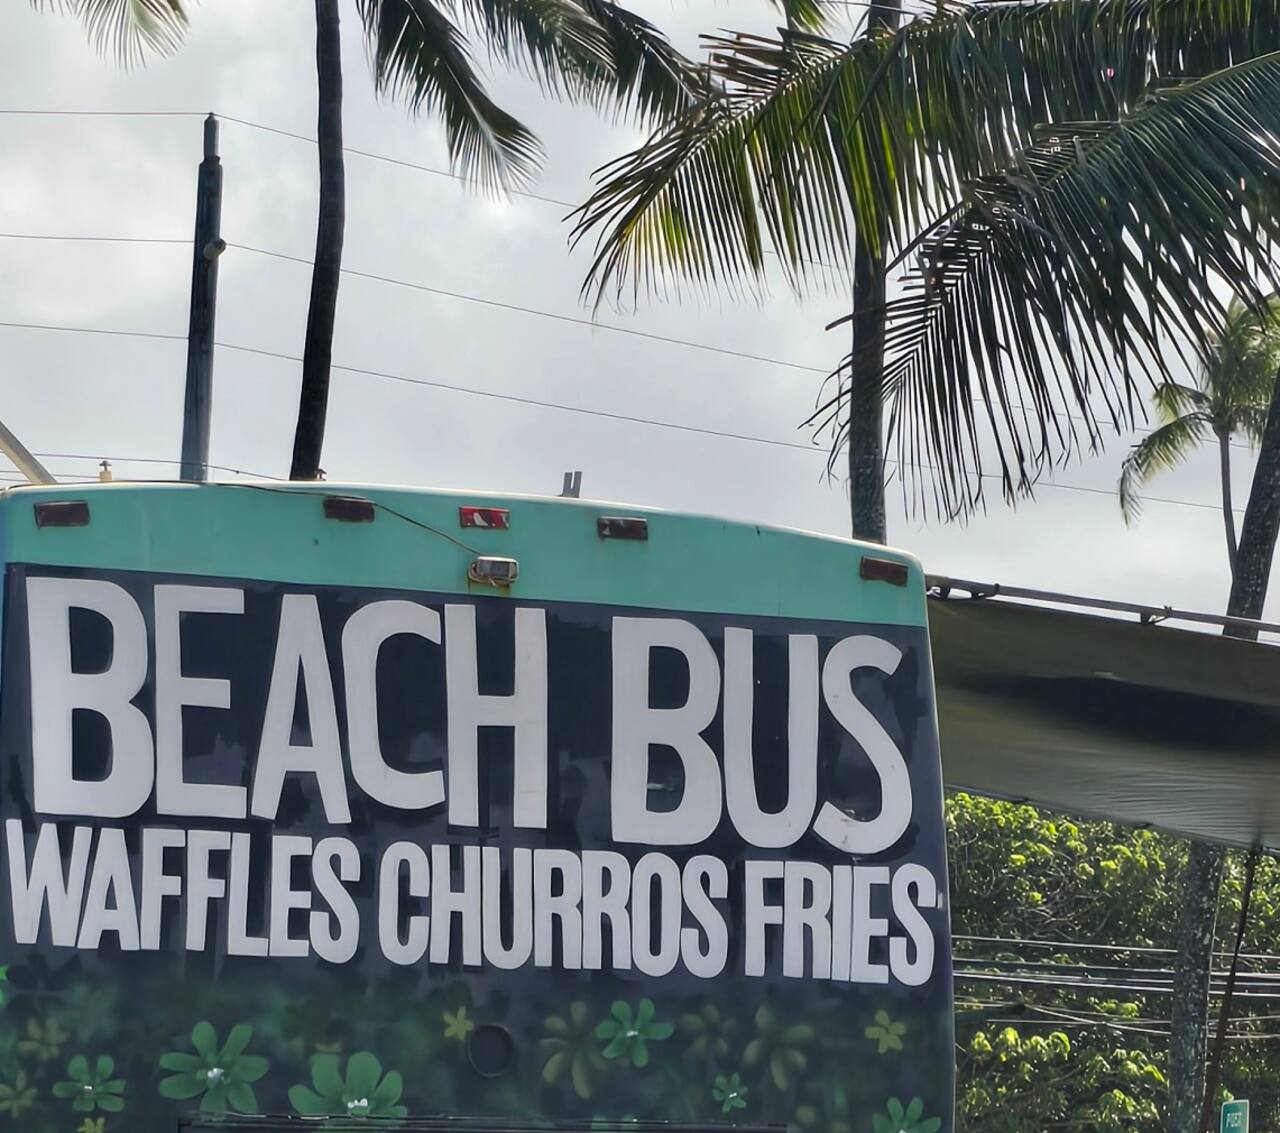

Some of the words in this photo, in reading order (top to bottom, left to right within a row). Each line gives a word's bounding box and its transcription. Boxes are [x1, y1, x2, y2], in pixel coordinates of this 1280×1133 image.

[25, 576, 548, 829] BEACH
[610, 616, 913, 854] BUS
[5, 818, 361, 964] WAFFLES
[378, 840, 729, 979] CHURROS
[744, 862, 937, 987] FRIES
